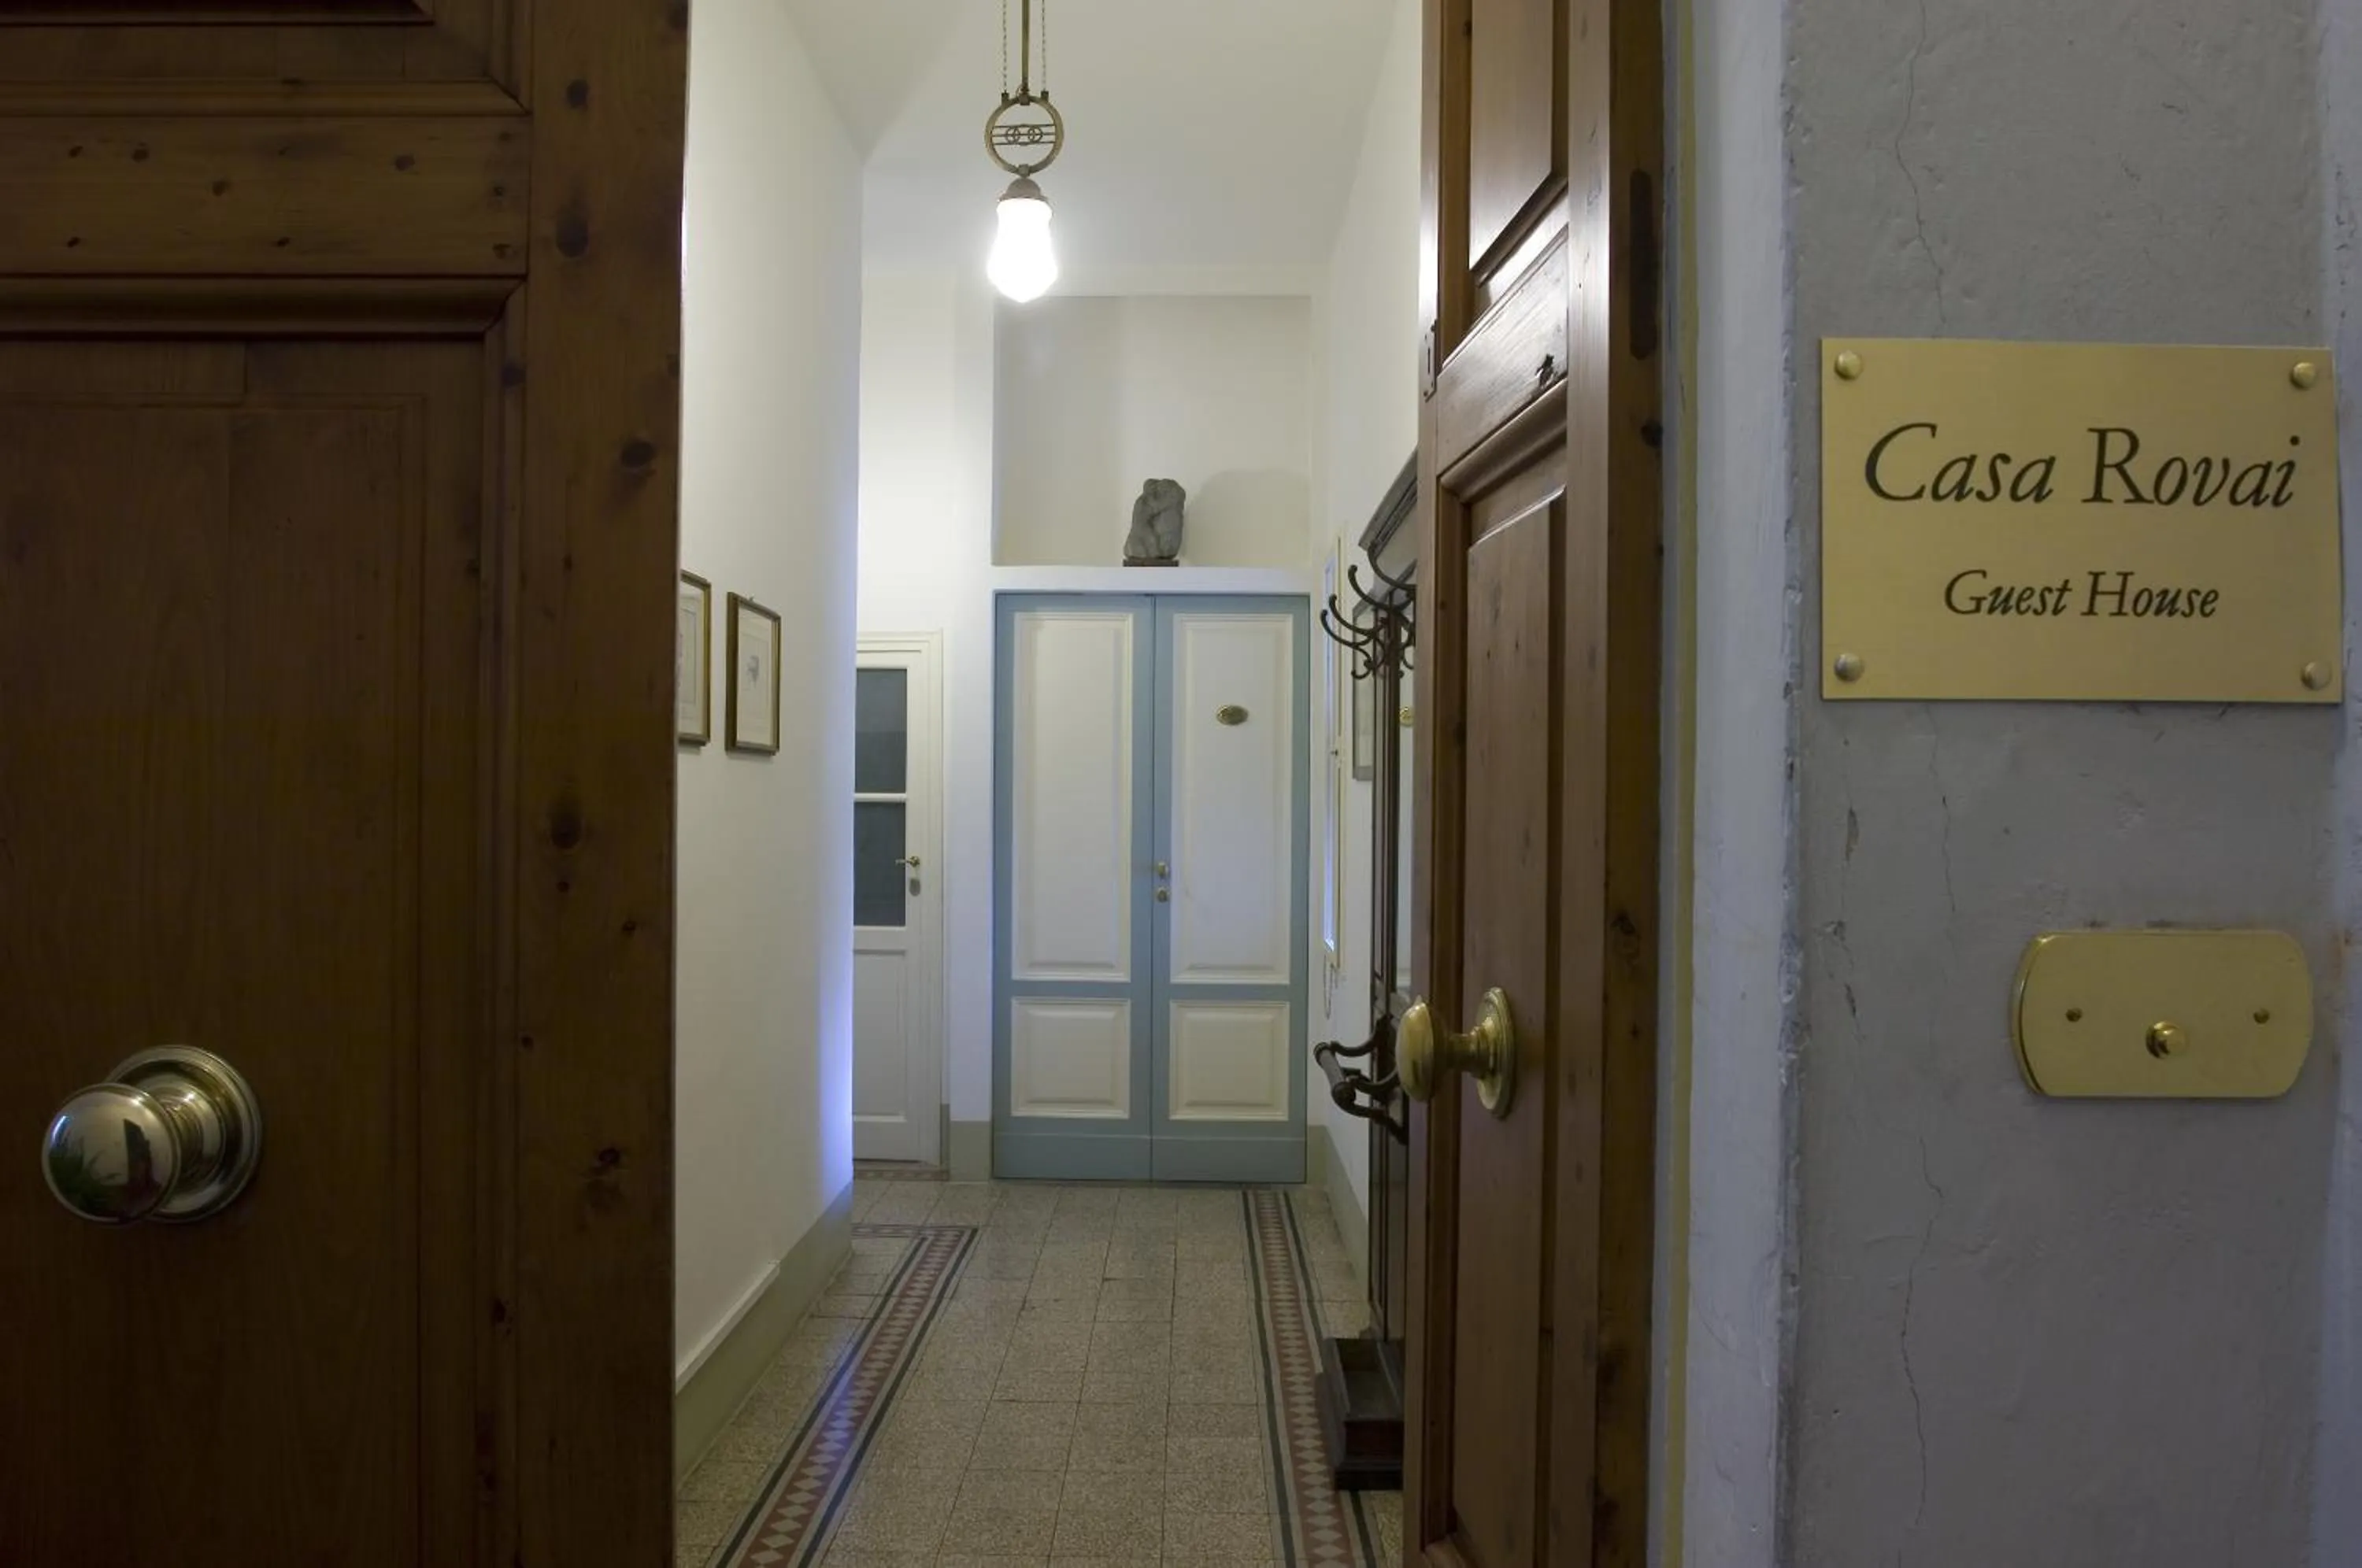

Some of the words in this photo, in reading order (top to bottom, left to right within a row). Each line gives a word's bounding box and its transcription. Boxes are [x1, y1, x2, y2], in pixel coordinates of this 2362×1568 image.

[1864, 423, 2057, 504] Casa
[2081, 427, 2301, 508] Rovai
[1944, 569, 2073, 617] Guest
[2080, 571, 2219, 619] House
